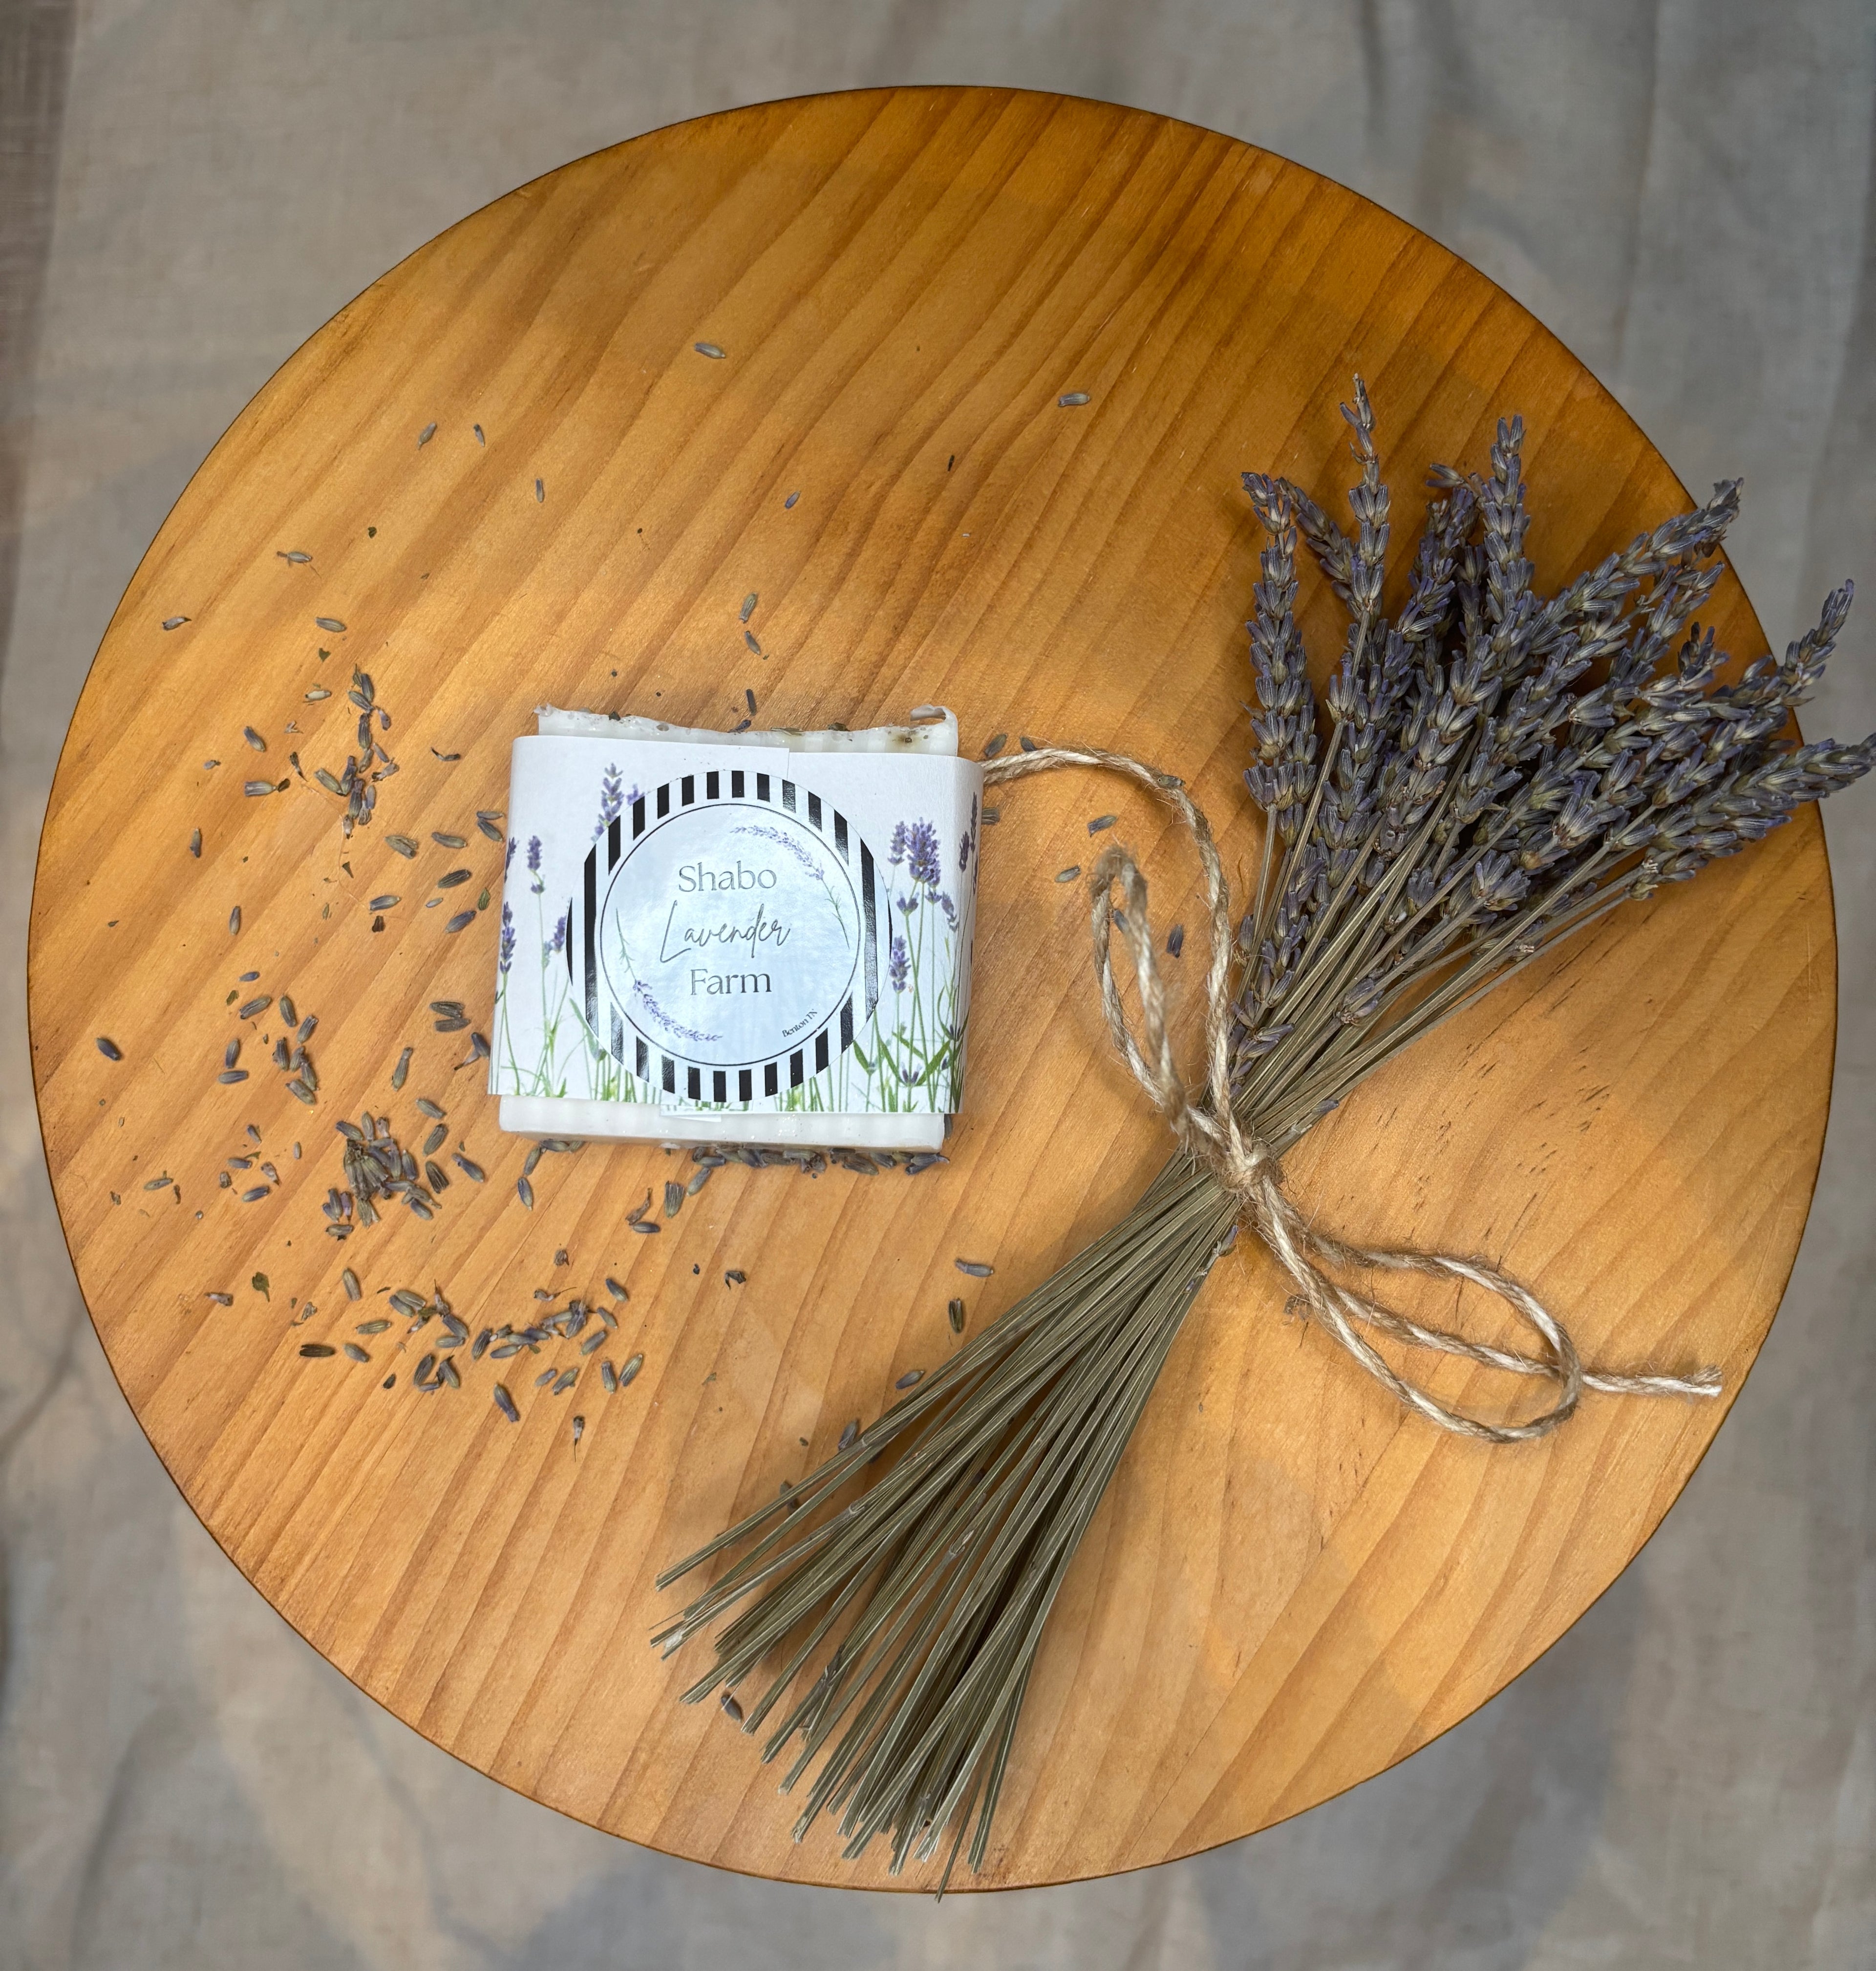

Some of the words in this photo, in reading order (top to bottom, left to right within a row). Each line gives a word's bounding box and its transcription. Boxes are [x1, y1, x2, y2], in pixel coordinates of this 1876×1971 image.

[679, 861, 777, 892] Shabo
[660, 899, 791, 963] Lavender
[690, 969, 772, 995] Farm
[782, 1018, 809, 1038] Benton
